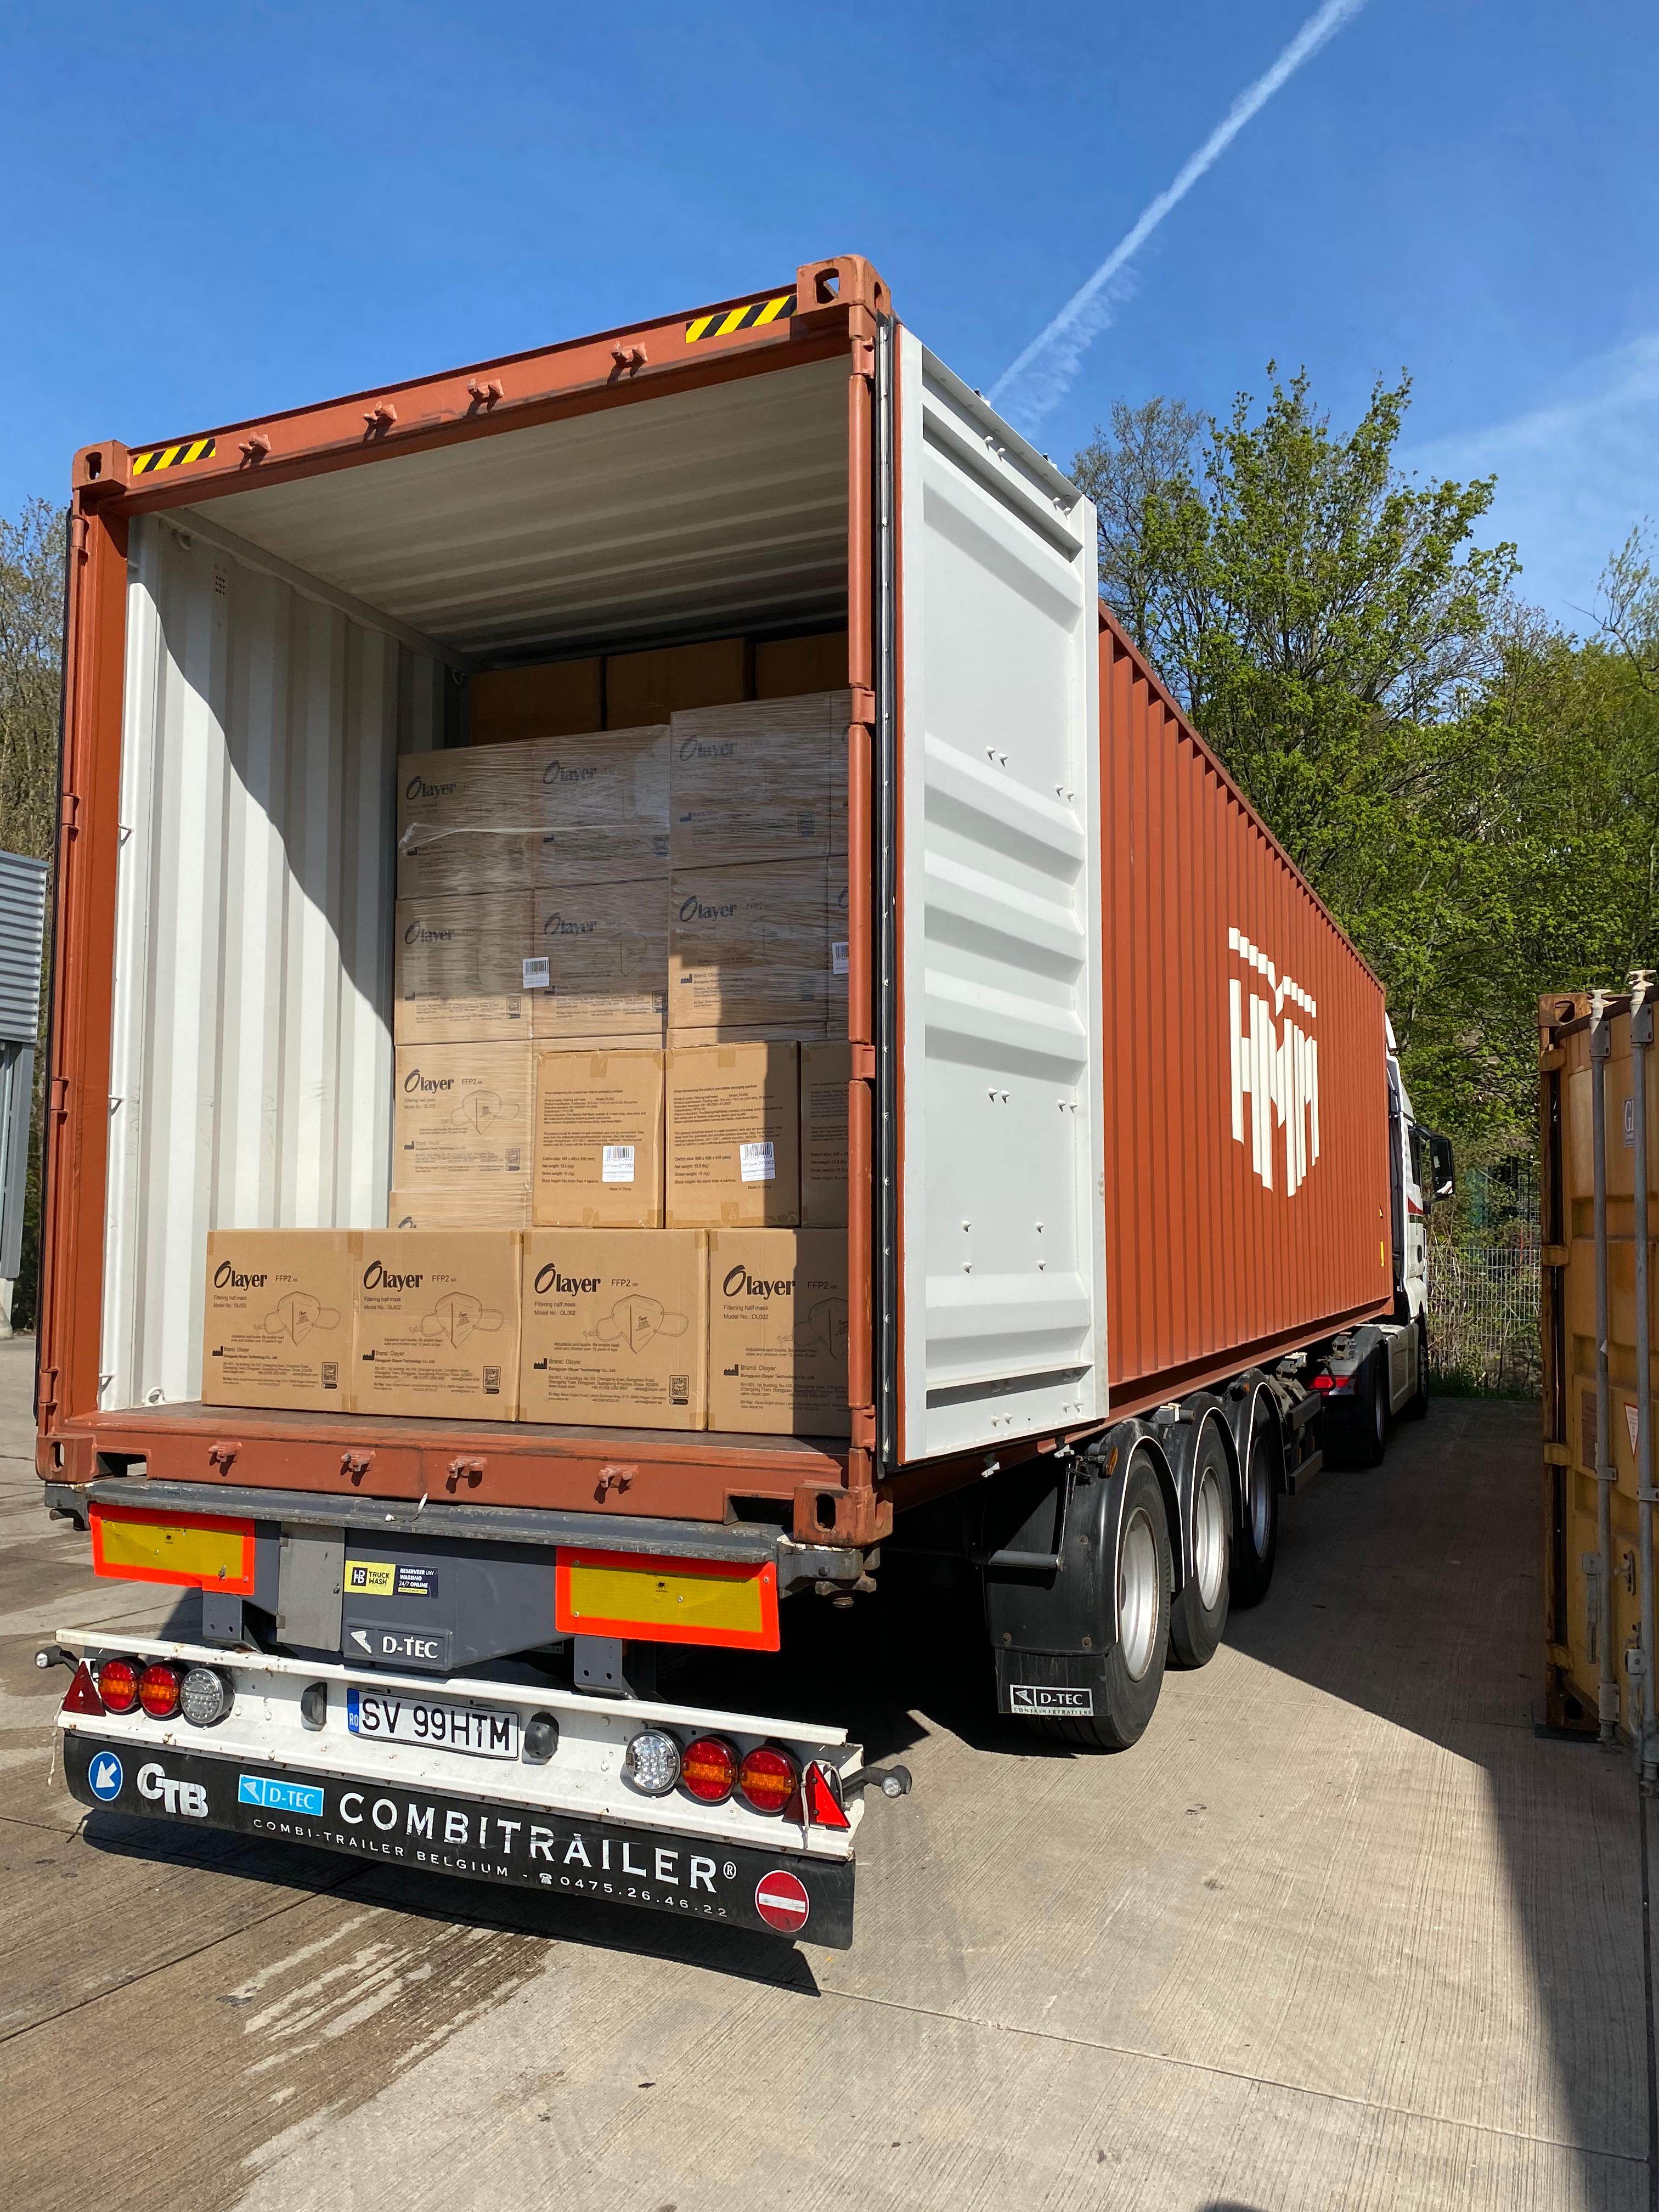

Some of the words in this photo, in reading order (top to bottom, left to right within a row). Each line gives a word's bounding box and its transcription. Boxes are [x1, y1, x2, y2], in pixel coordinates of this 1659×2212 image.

[405, 776, 456, 799] Olayer
[679, 895, 737, 922] Olayer
[404, 921, 454, 944] Olayer
[544, 912, 597, 937] Olayer
[404, 1069, 454, 1093] Olayer
[214, 1261, 267, 1291] Olayer
[364, 1260, 423, 1292] Olayer
[534, 1263, 601, 1296] Olayer
[724, 1265, 795, 1299] Olayer
[382, 1635, 438, 1659] D-TEC
[1040, 1692, 1084, 1705] D-TEC
[349, 1712, 359, 1727] RO
[362, 1699, 402, 1734] SV
[413, 1705, 510, 1751] 99HTM
[269, 1787, 315, 1809] D-TEC
[253, 1819, 404, 1857] COMBI-TRAILER
[417, 1850, 508, 1877] BELGIUM
